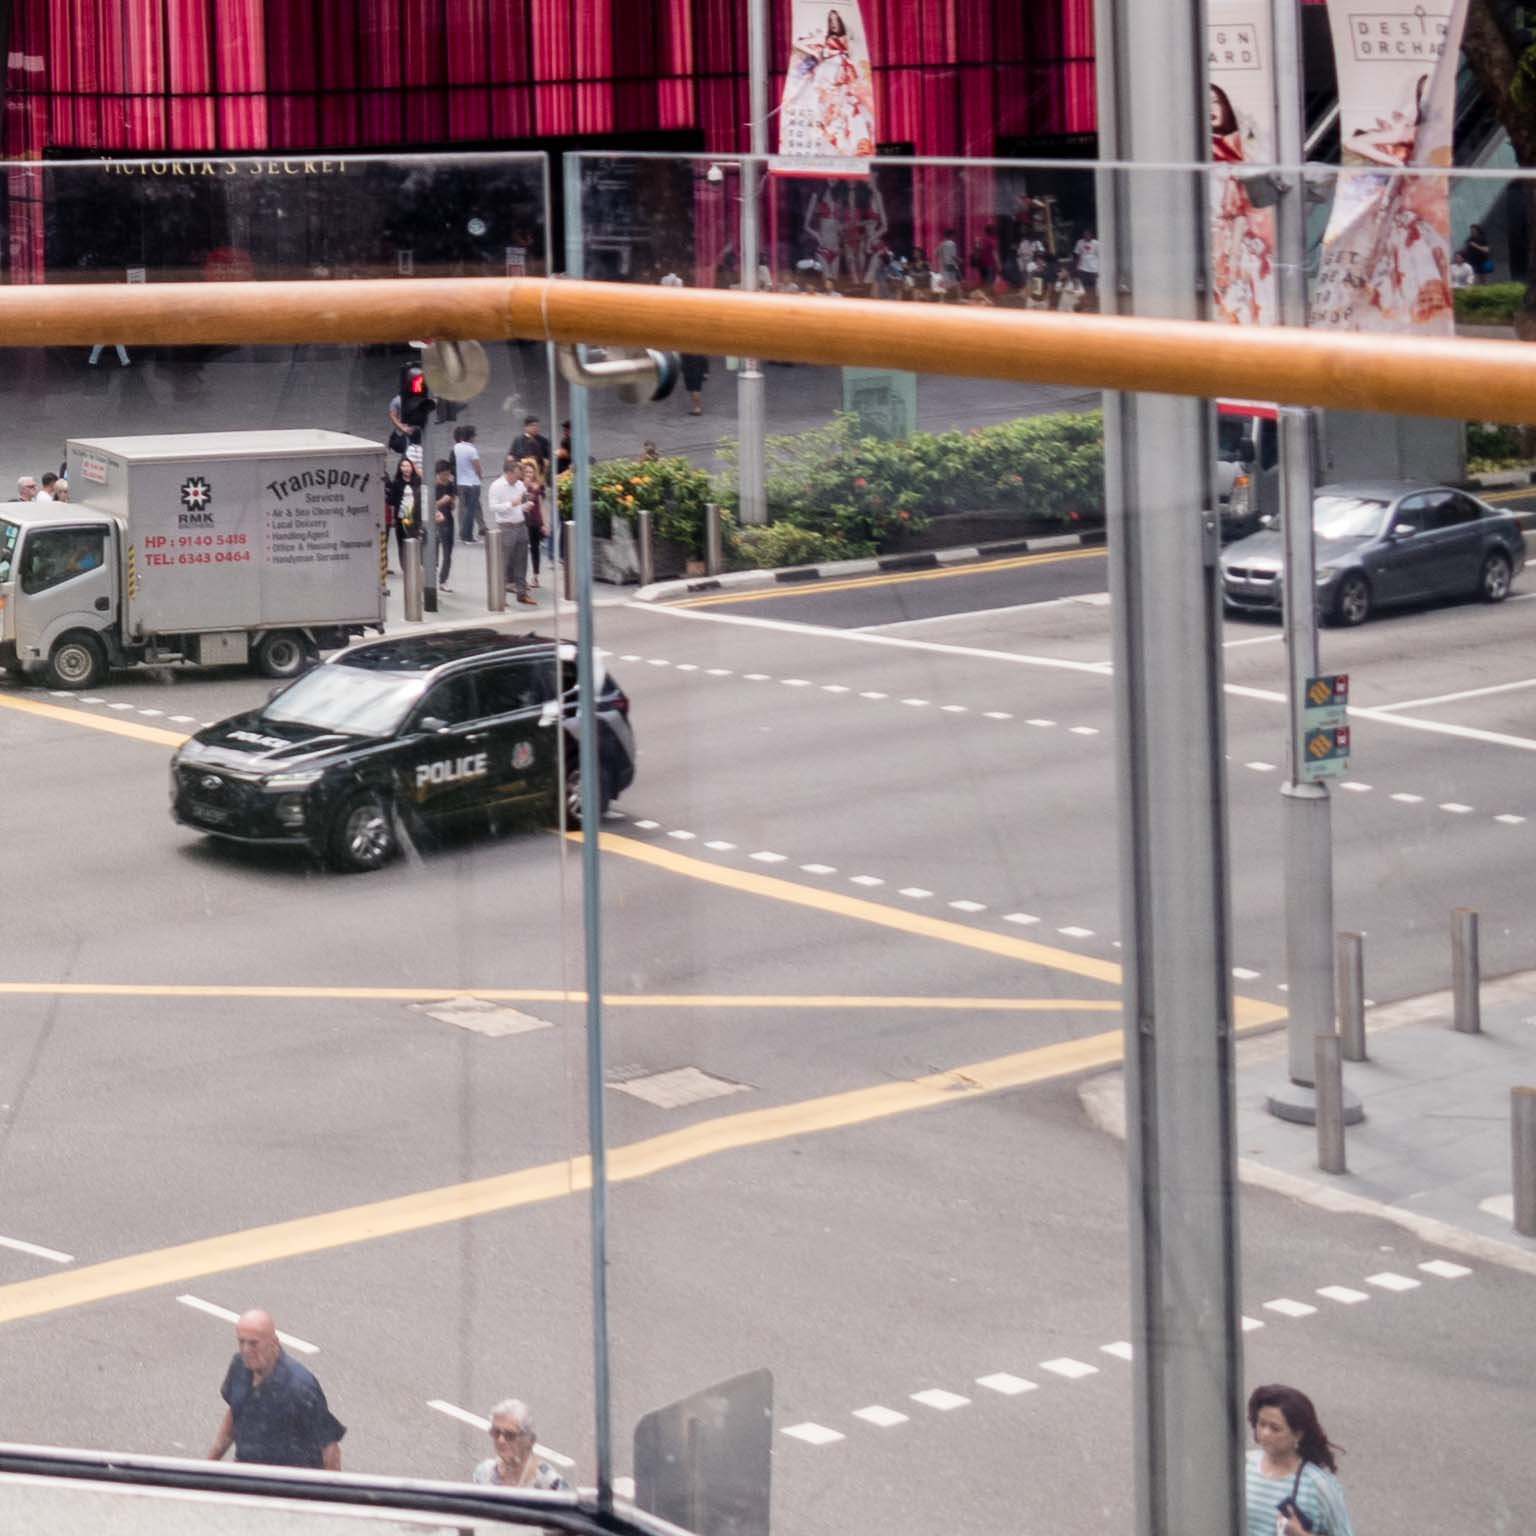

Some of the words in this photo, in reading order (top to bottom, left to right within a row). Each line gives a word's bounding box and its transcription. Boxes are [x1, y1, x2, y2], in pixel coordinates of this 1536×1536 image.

[100, 156, 237, 176] VICTORIAS
[249, 158, 346, 175] SECRET
[266, 468, 370, 501] Transport
[305, 493, 345, 503] Services
[347, 505, 369, 516] Agent
[178, 513, 214, 523] RMK
[272, 520, 293, 529] Local
[295, 519, 327, 528] Delivery
[272, 532, 306, 541] Handling
[307, 530, 329, 541] Agent
[144, 536, 166, 548] HP
[178, 535, 213, 547] 9140
[273, 544, 295, 552] Office
[144, 554, 175, 566] TEL:
[178, 552, 211, 564] 6343
[214, 550, 250, 562] 0464
[273, 555, 314, 564] Handyman
[226, 730, 293, 749] POLICE
[415, 753, 488, 788] POLICE
